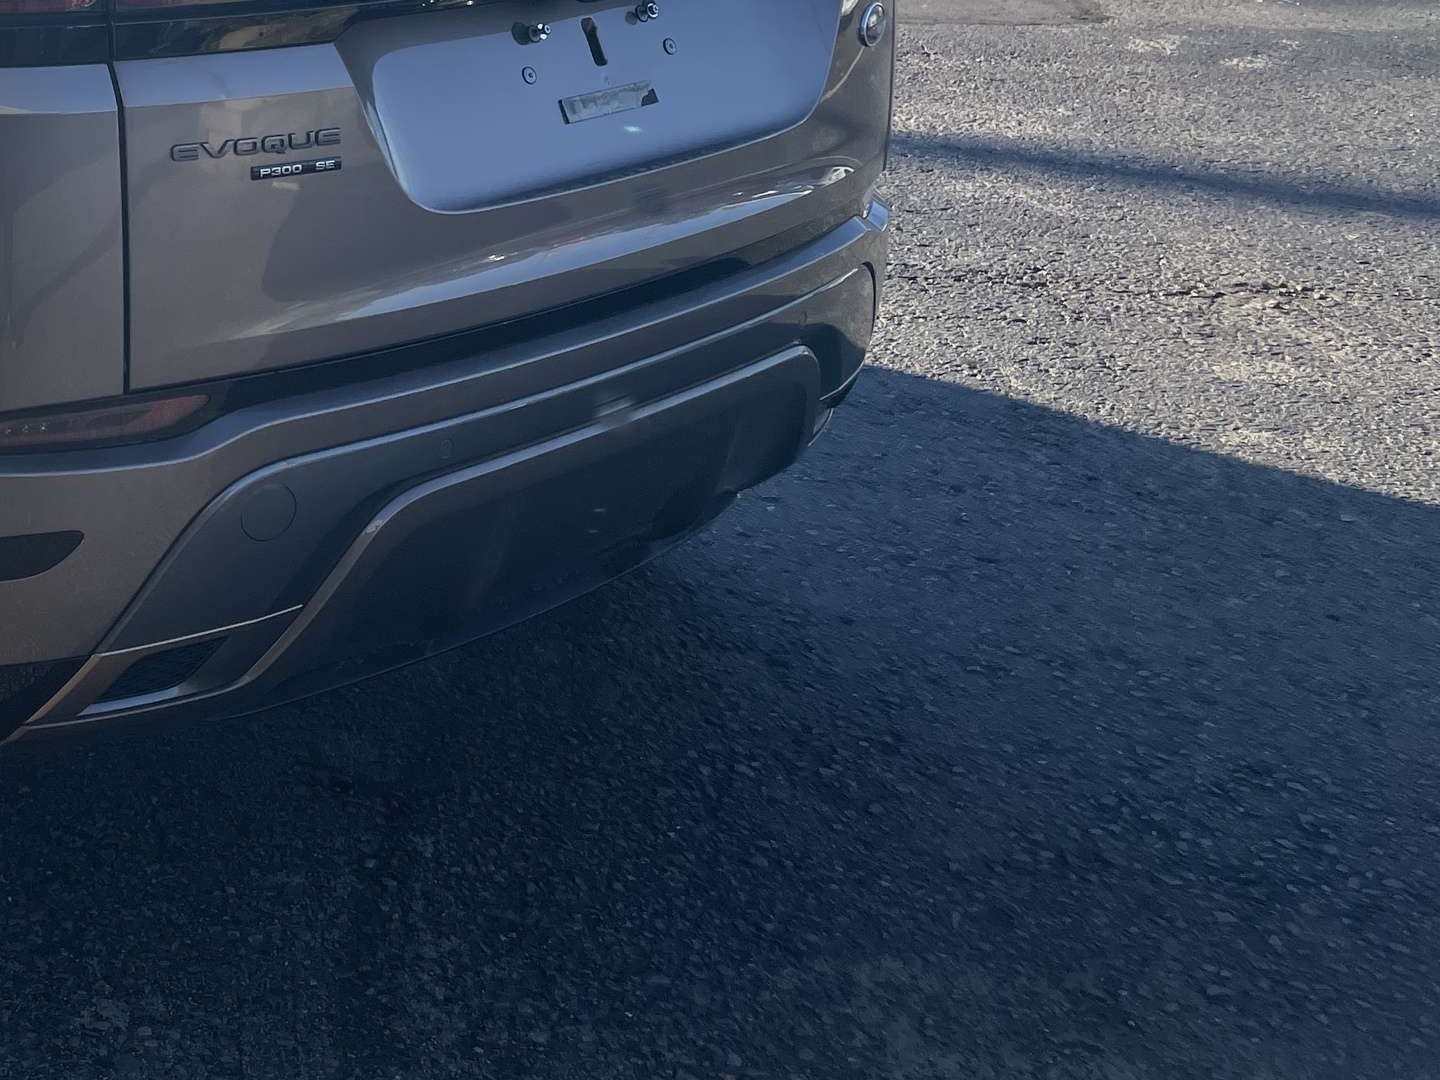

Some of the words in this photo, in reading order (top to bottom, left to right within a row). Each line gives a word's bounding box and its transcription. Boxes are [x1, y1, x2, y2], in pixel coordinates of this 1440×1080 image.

[170, 127, 342, 162] EVOQUE
[259, 164, 302, 178] P300
[315, 160, 336, 171] SE
